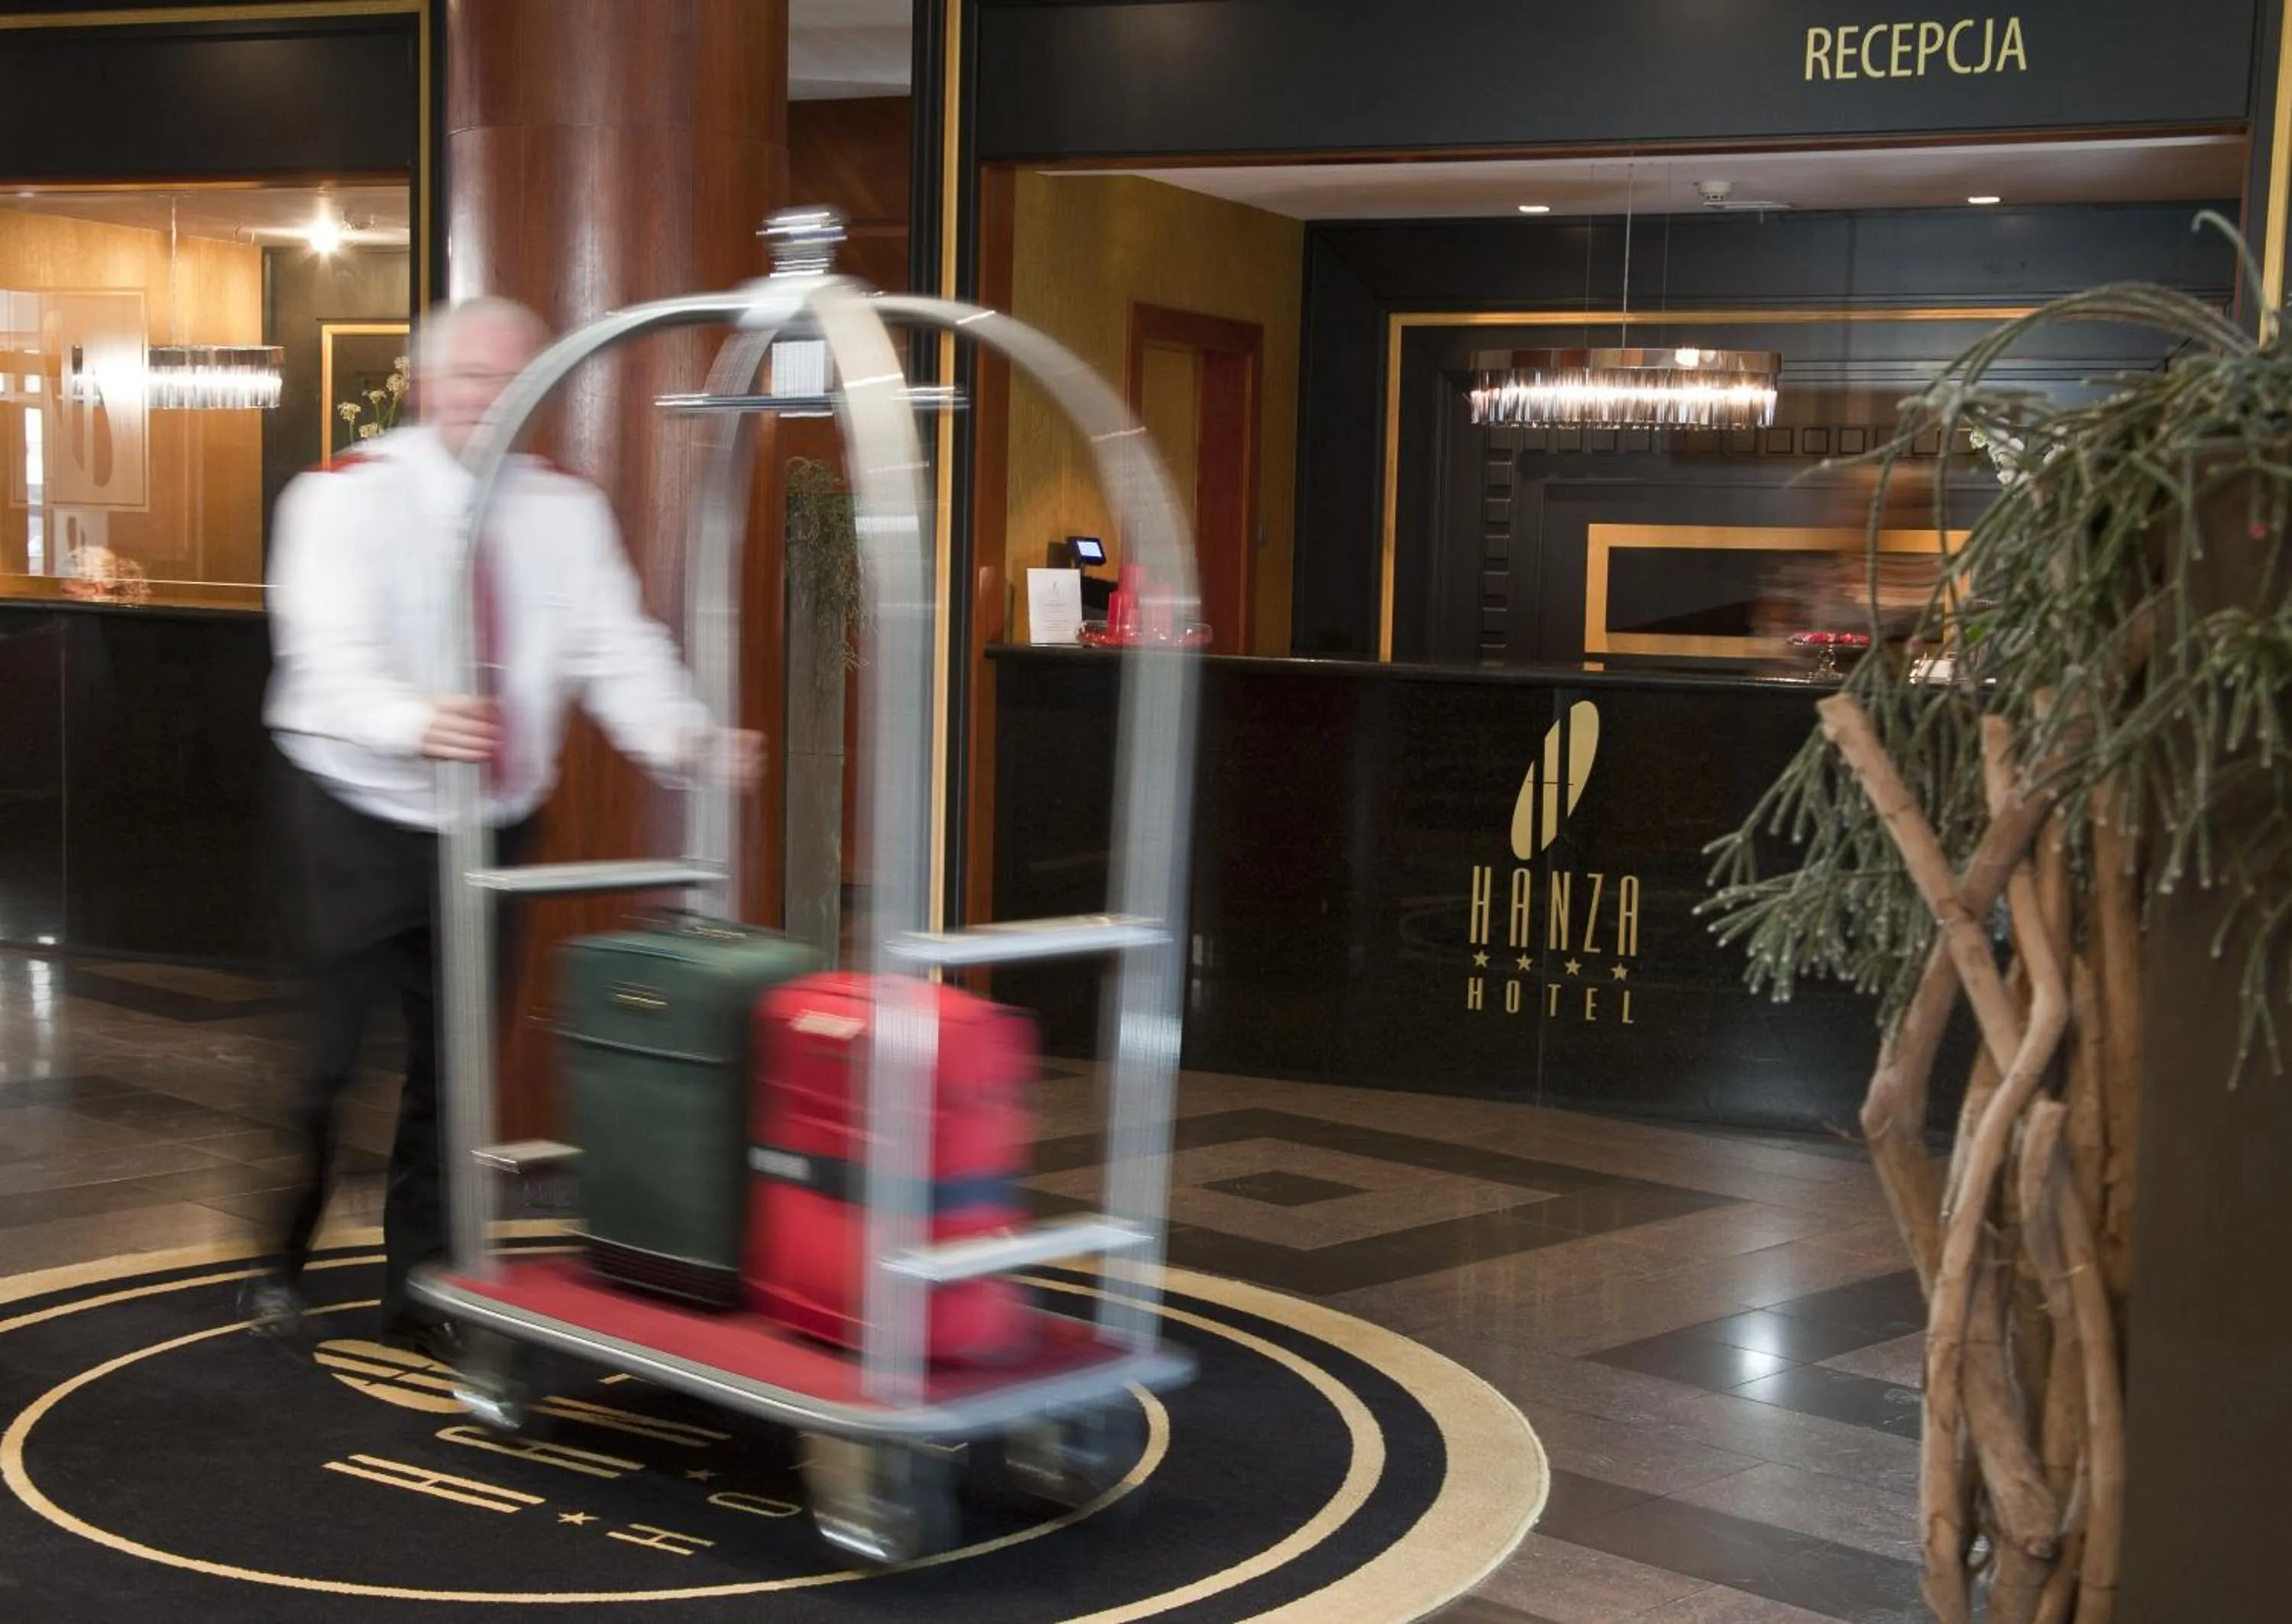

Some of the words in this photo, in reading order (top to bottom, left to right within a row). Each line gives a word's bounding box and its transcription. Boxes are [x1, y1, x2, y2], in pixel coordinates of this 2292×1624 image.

[1805, 17, 2027, 80] RECEPCJA
[1469, 865, 1639, 956] HANZA
[1467, 977, 1634, 1024] HOTEL
